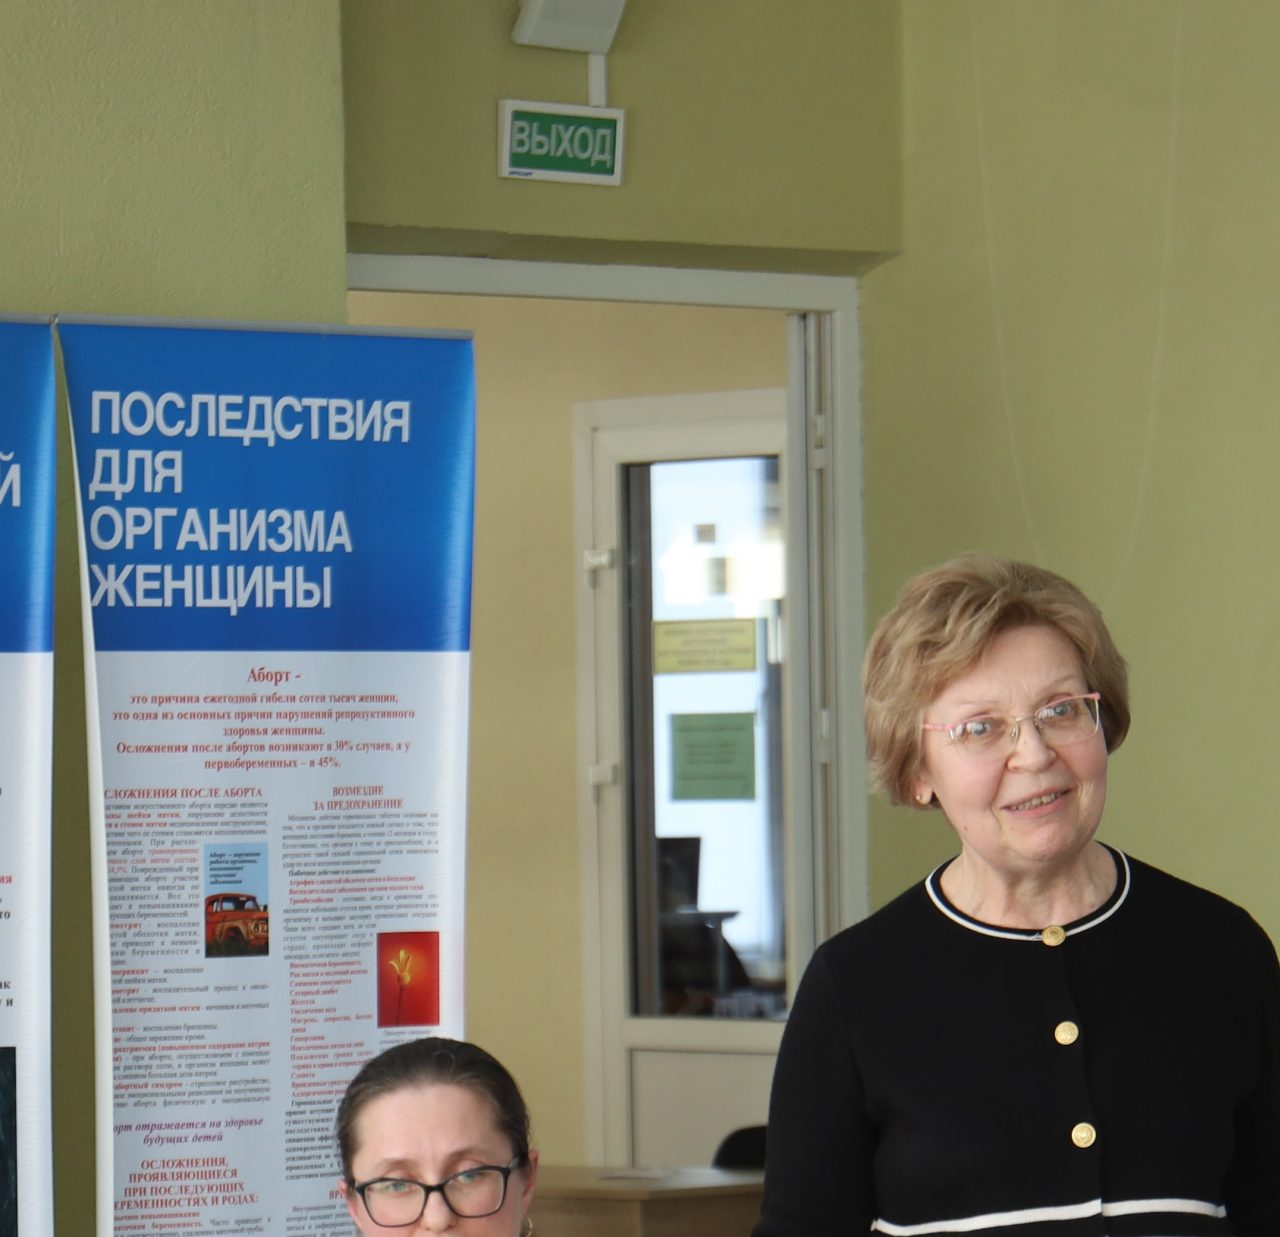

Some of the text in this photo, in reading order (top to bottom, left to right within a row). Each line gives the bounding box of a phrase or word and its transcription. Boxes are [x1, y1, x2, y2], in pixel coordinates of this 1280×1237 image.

[512, 121, 611, 167] ВЫХОД
[91, 390, 410, 447] ПОСЛЕДСТВИЯ
[88, 449, 183, 500] ДЛЯ
[90, 506, 353, 553] ОРГАНИЗМА
[91, 564, 332, 616] ЖЕНЩИНЫ
[248, 667, 291, 686] Аборт
[130, 695, 147, 704] это
[151, 695, 200, 707] причина
[203, 693, 257, 704] ежегодной
[261, 692, 295, 704] гибели
[299, 694, 326, 704] сотен
[112, 708, 416, 722] это одна из основных причин нарушений репродуктивного
[223, 727, 326, 738] здоровья женщины.
[116, 742, 188, 754] Осложнения
[192, 743, 223, 753] после
[226, 741, 265, 755] абортов
[269, 742, 324, 752] возникают
[327, 743, 331, 752] в
[335, 740, 353, 752] 30%
[204, 758, 298, 772] первобеременных
[309, 760, 315, 768] в
[318, 756, 342, 769] 45%.
[181, 788, 221, 798] ПОСЛЕ
[223, 788, 262, 797] АБОРТА
[333, 785, 384, 797] ВОЗМЕЗДИЕ
[314, 799, 404, 811] ЗА ПРЕДОХРАНЕНИЕ
[135, 1120, 206, 1134] отражается
[209, 1119, 221, 1129] на
[224, 1117, 264, 1129] здоровье
[142, 1132, 223, 1147] будущих детей
[141, 1157, 228, 1170] ОСЛОЖНЕНИЯ,
[128, 1168, 238, 1184] ПРОЯВЛЯЮЩИЕСЯ
[124, 1182, 245, 1198] ПРИ ПОСЛЕДУЮЩИХ
[211, 1197, 219, 1206] И
[222, 1195, 259, 1206] РОДАХ:
